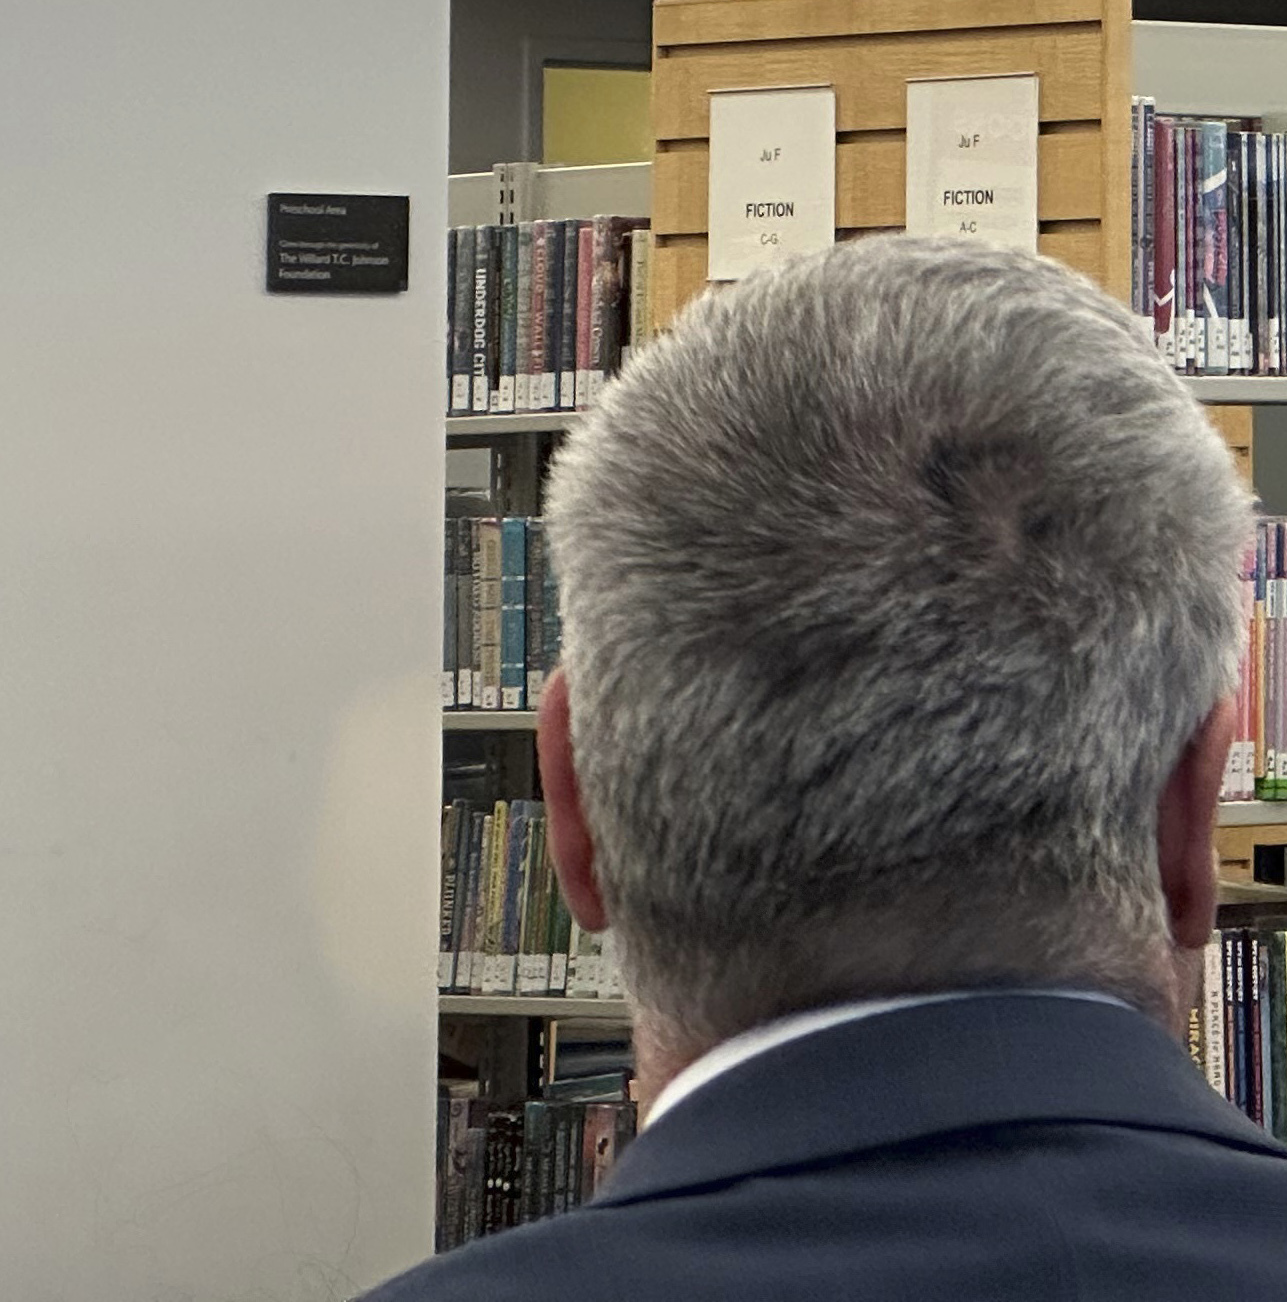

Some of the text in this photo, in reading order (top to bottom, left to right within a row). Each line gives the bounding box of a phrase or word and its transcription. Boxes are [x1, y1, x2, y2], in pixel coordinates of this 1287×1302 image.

[973, 134, 980, 147] F
[774, 149, 781, 161] F
[943, 190, 994, 206] FICTION
[746, 202, 794, 218] FICTION
[959, 221, 977, 234] A-C
[279, 252, 297, 264] The
[473, 268, 488, 376] UNDERDOG CIT
[1188, 1008, 1201, 1066] MIRA
